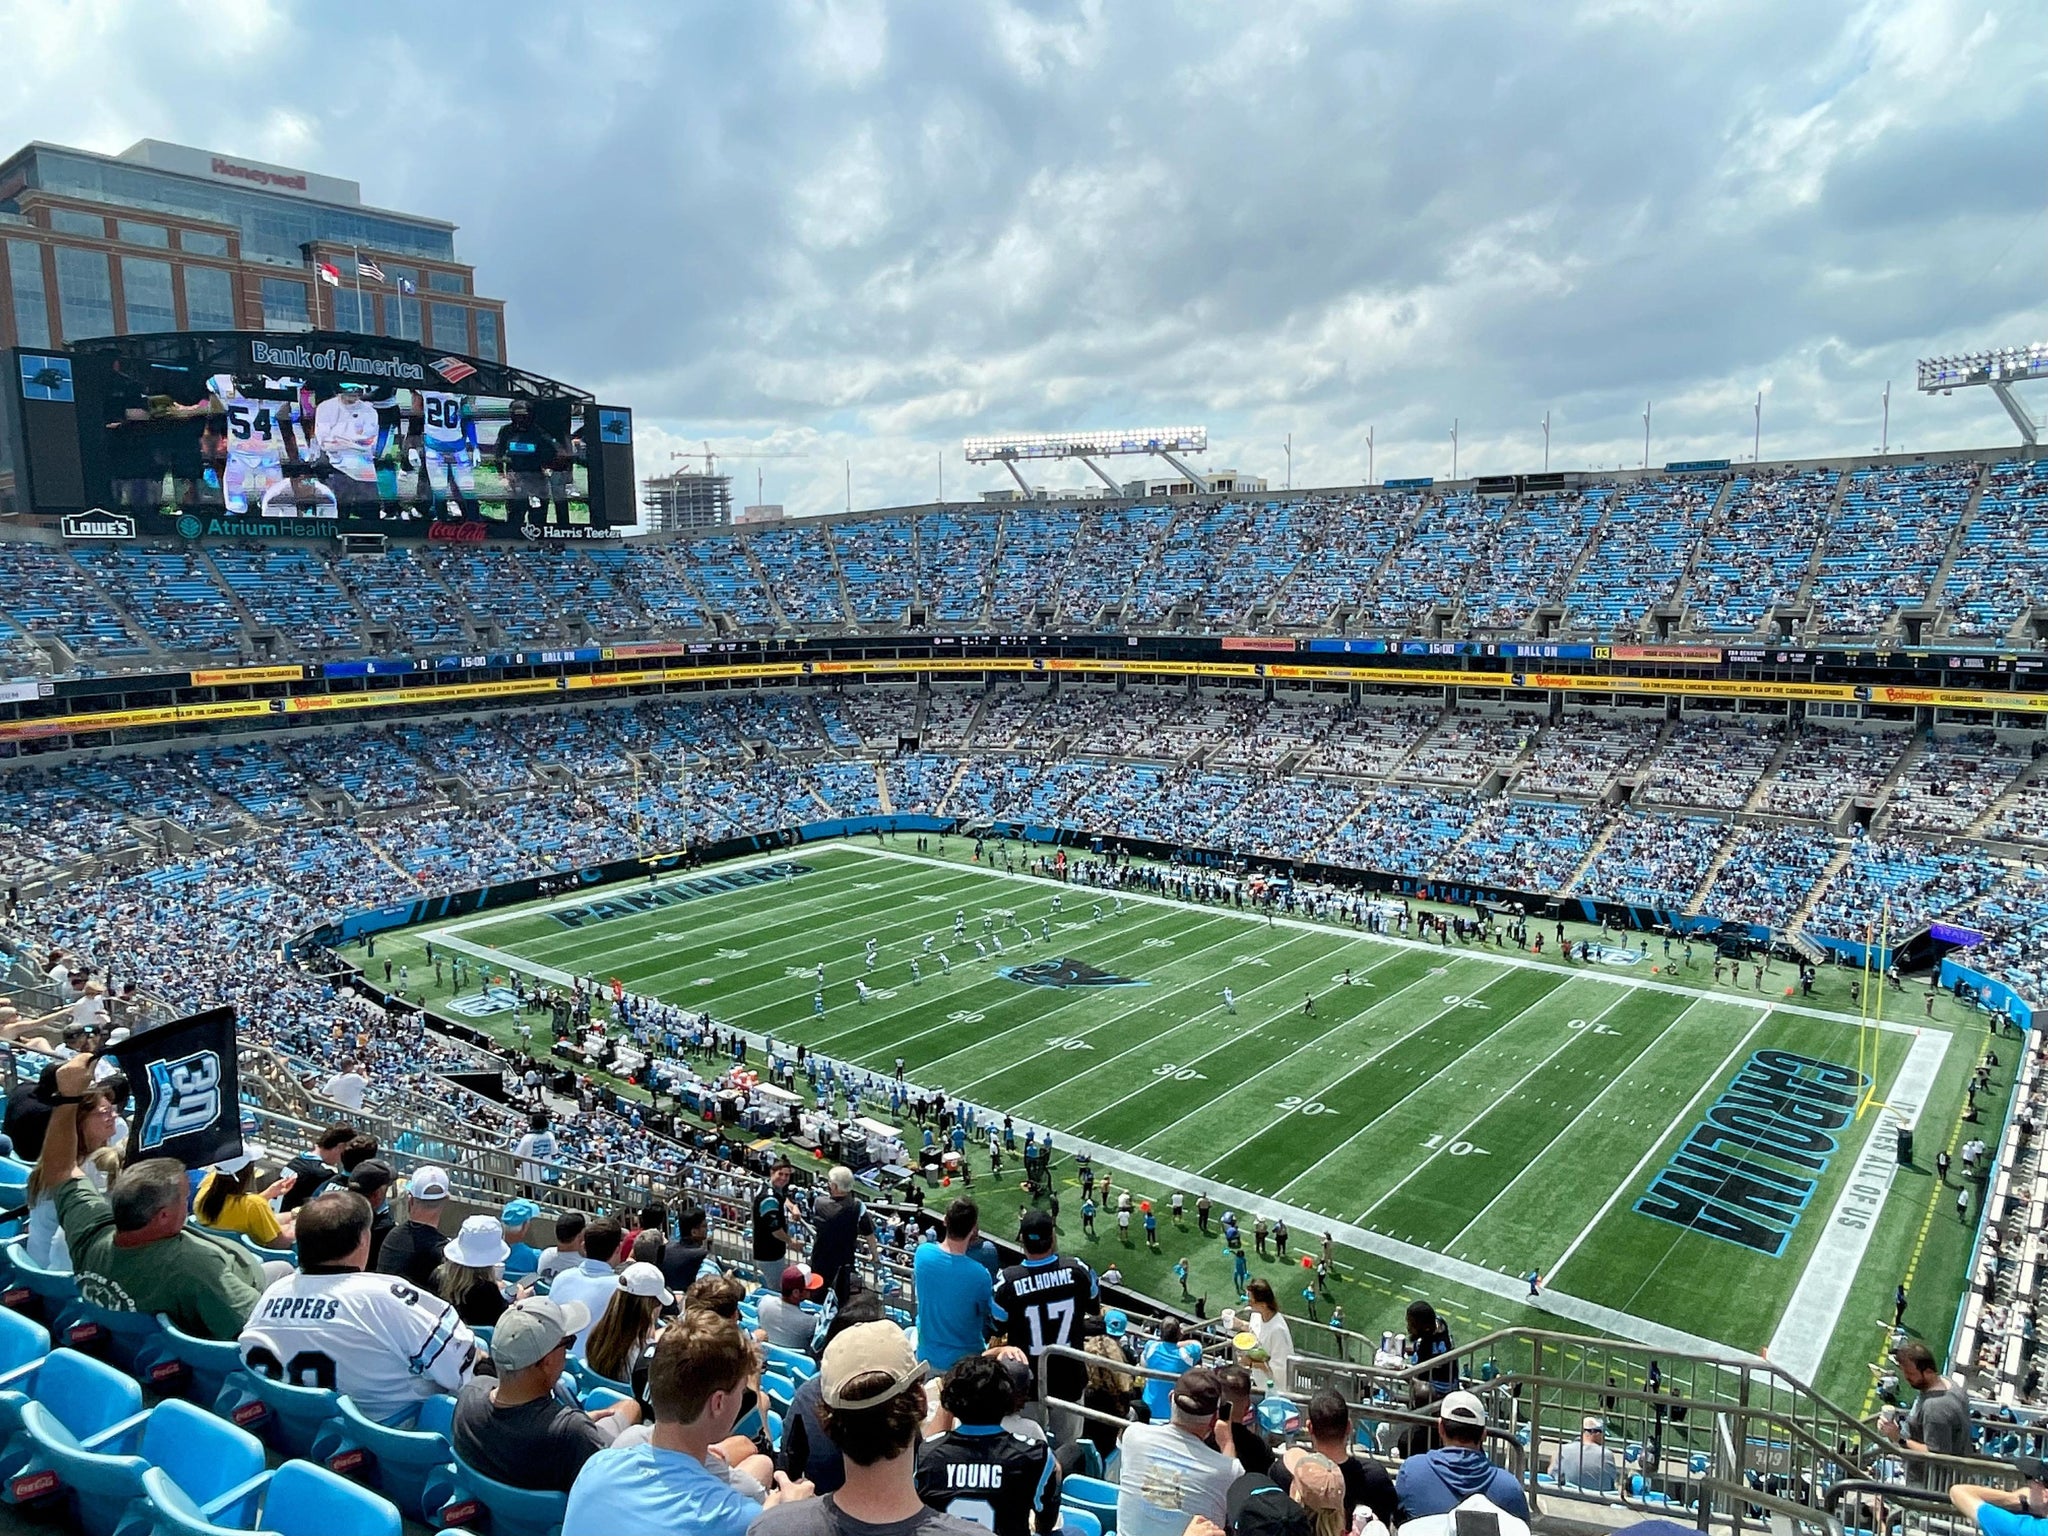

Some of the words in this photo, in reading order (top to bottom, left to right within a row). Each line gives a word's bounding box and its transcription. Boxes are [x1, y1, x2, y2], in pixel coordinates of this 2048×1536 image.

[211, 158, 306, 190] Honeywell
[252, 340, 312, 368] Bank
[312, 349, 336, 370] of
[337, 351, 424, 380] America
[227, 406, 272, 441] 54
[426, 397, 459, 428] 20
[69, 519, 129, 535] LOWE'S
[207, 519, 277, 535] Atrium
[279, 521, 339, 536] Health
[543, 526, 582, 539] Harris
[584, 527, 621, 539] Teeter
[1429, 644, 1454, 654] 15:00
[1517, 645, 1541, 657] BALL
[1544, 646, 1558, 657] ON
[461, 656, 486, 668] 15:00
[1535, 674, 1572, 687] Bojangles
[1886, 687, 1934, 701] Bojangles
[548, 861, 816, 929] PANTHERS
[946, 1010, 986, 1024] 50
[1152, 1063, 1197, 1081] 30
[1275, 1096, 1326, 1116] 20
[1418, 1133, 1474, 1156] 10
[1633, 1049, 1873, 1258] CAROLINA
[1858, 1153, 1893, 1186] ALL
[1848, 1185, 1881, 1205] OF
[1837, 1206, 1873, 1230] US
[1013, 1268, 1075, 1296] DELHOMME
[263, 1297, 339, 1320] PEPPERS
[1025, 1296, 1075, 1356] 17
[946, 1463, 1003, 1488] YOUNG
